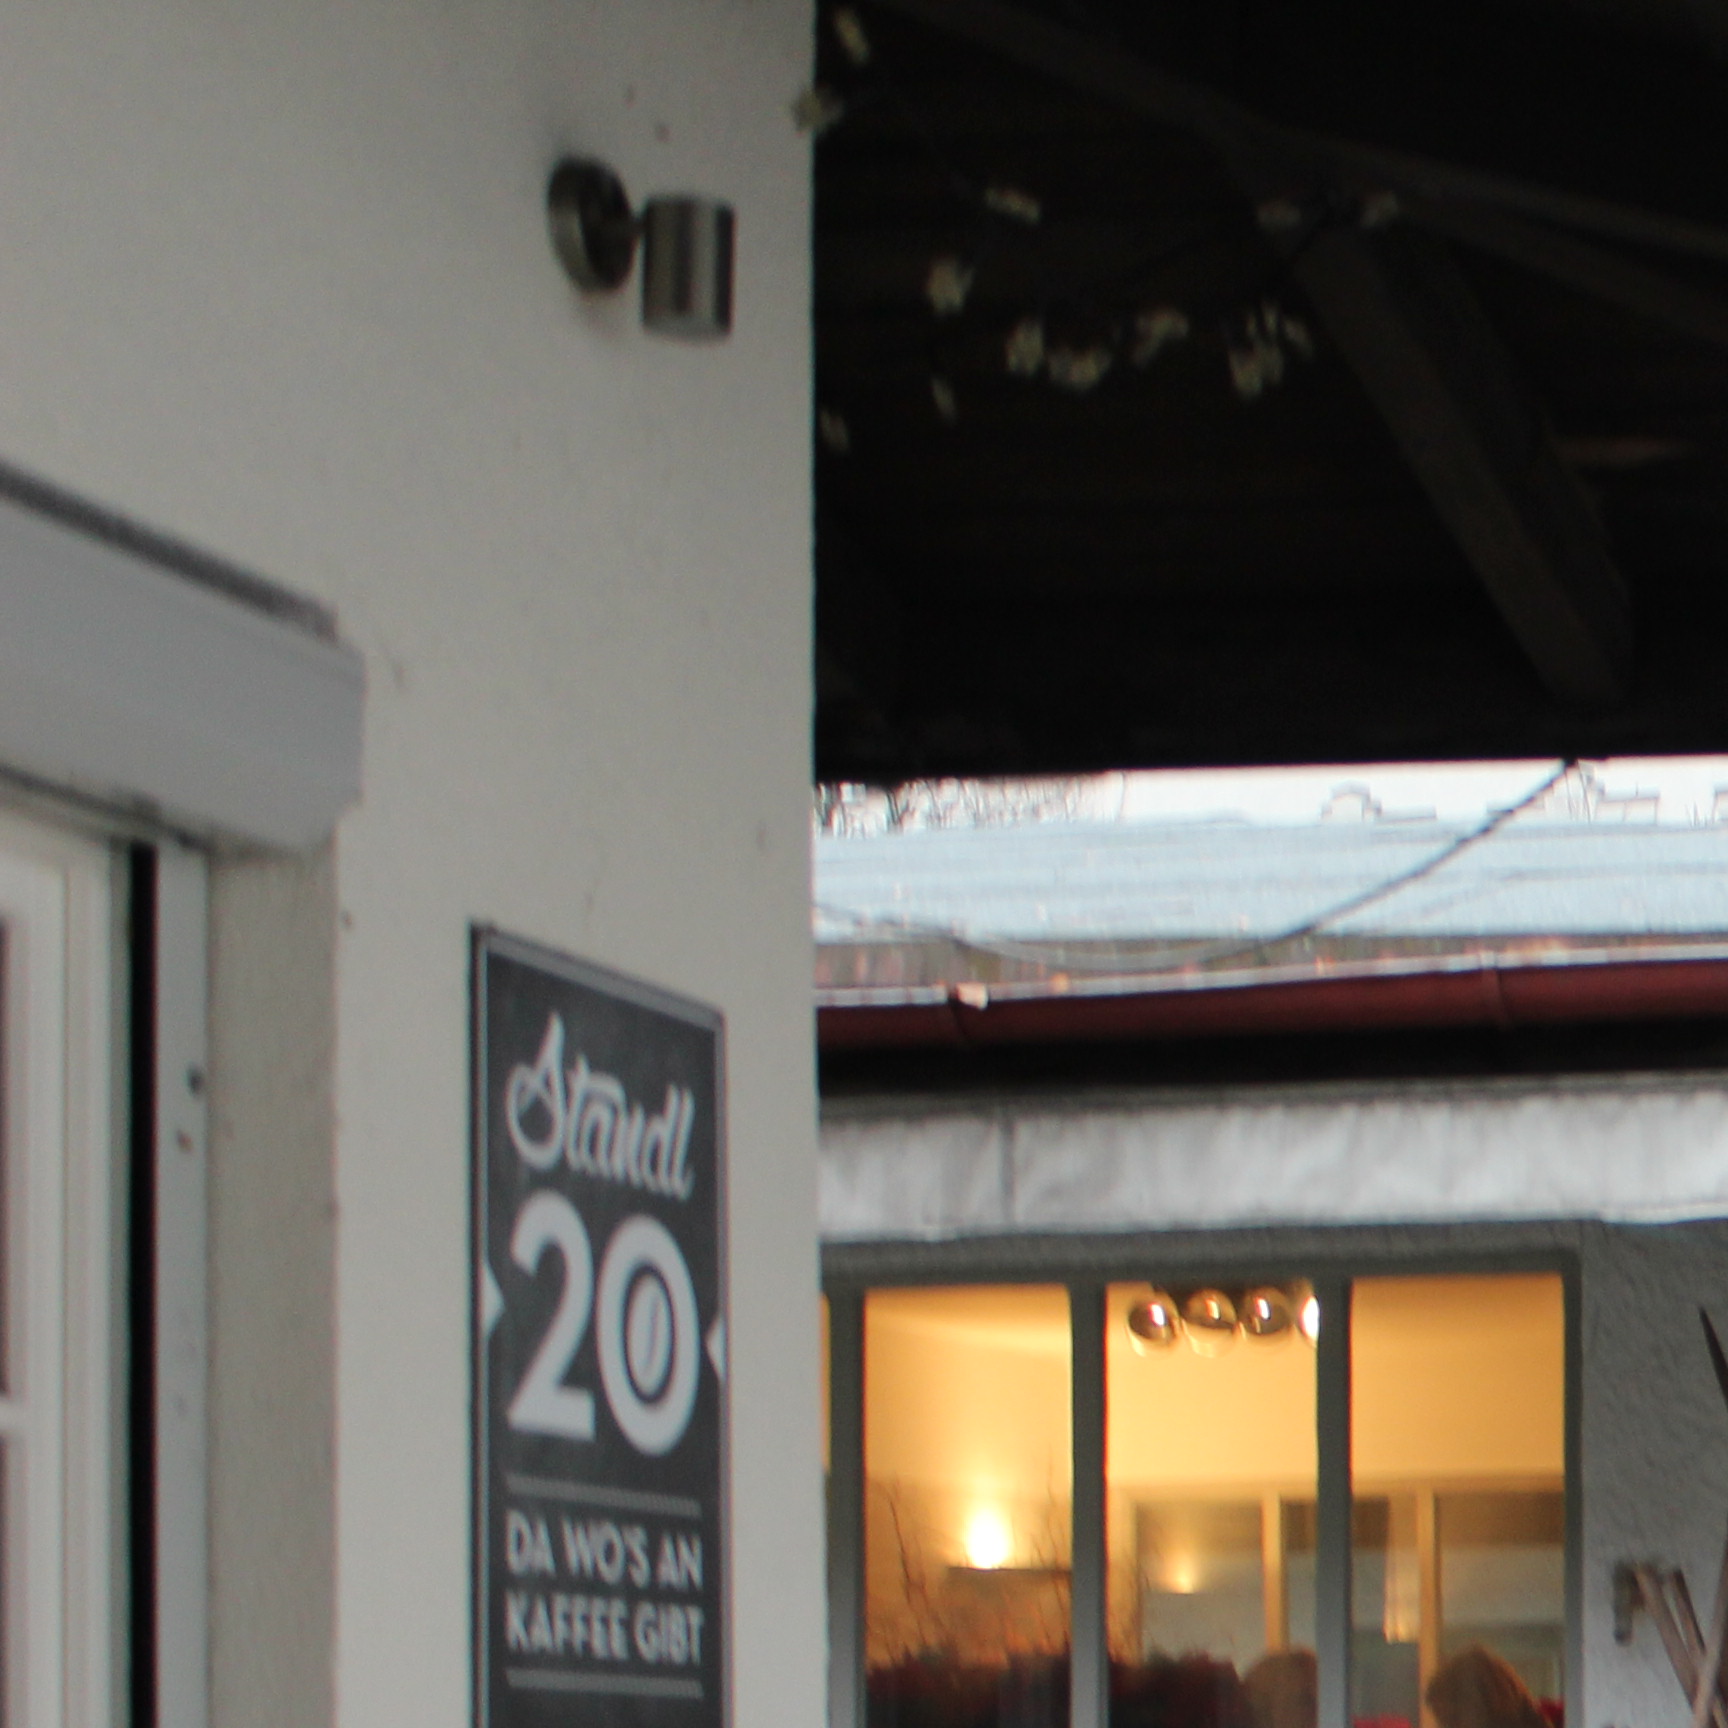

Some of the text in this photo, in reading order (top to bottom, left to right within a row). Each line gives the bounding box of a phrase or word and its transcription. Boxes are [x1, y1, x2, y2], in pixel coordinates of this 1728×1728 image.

[505, 1011, 696, 1201] Standl
[506, 1188, 701, 1456] 20
[505, 1508, 557, 1578] DA
[656, 1530, 704, 1594] AN
[505, 1588, 705, 1668] KAFFEE GIBT
